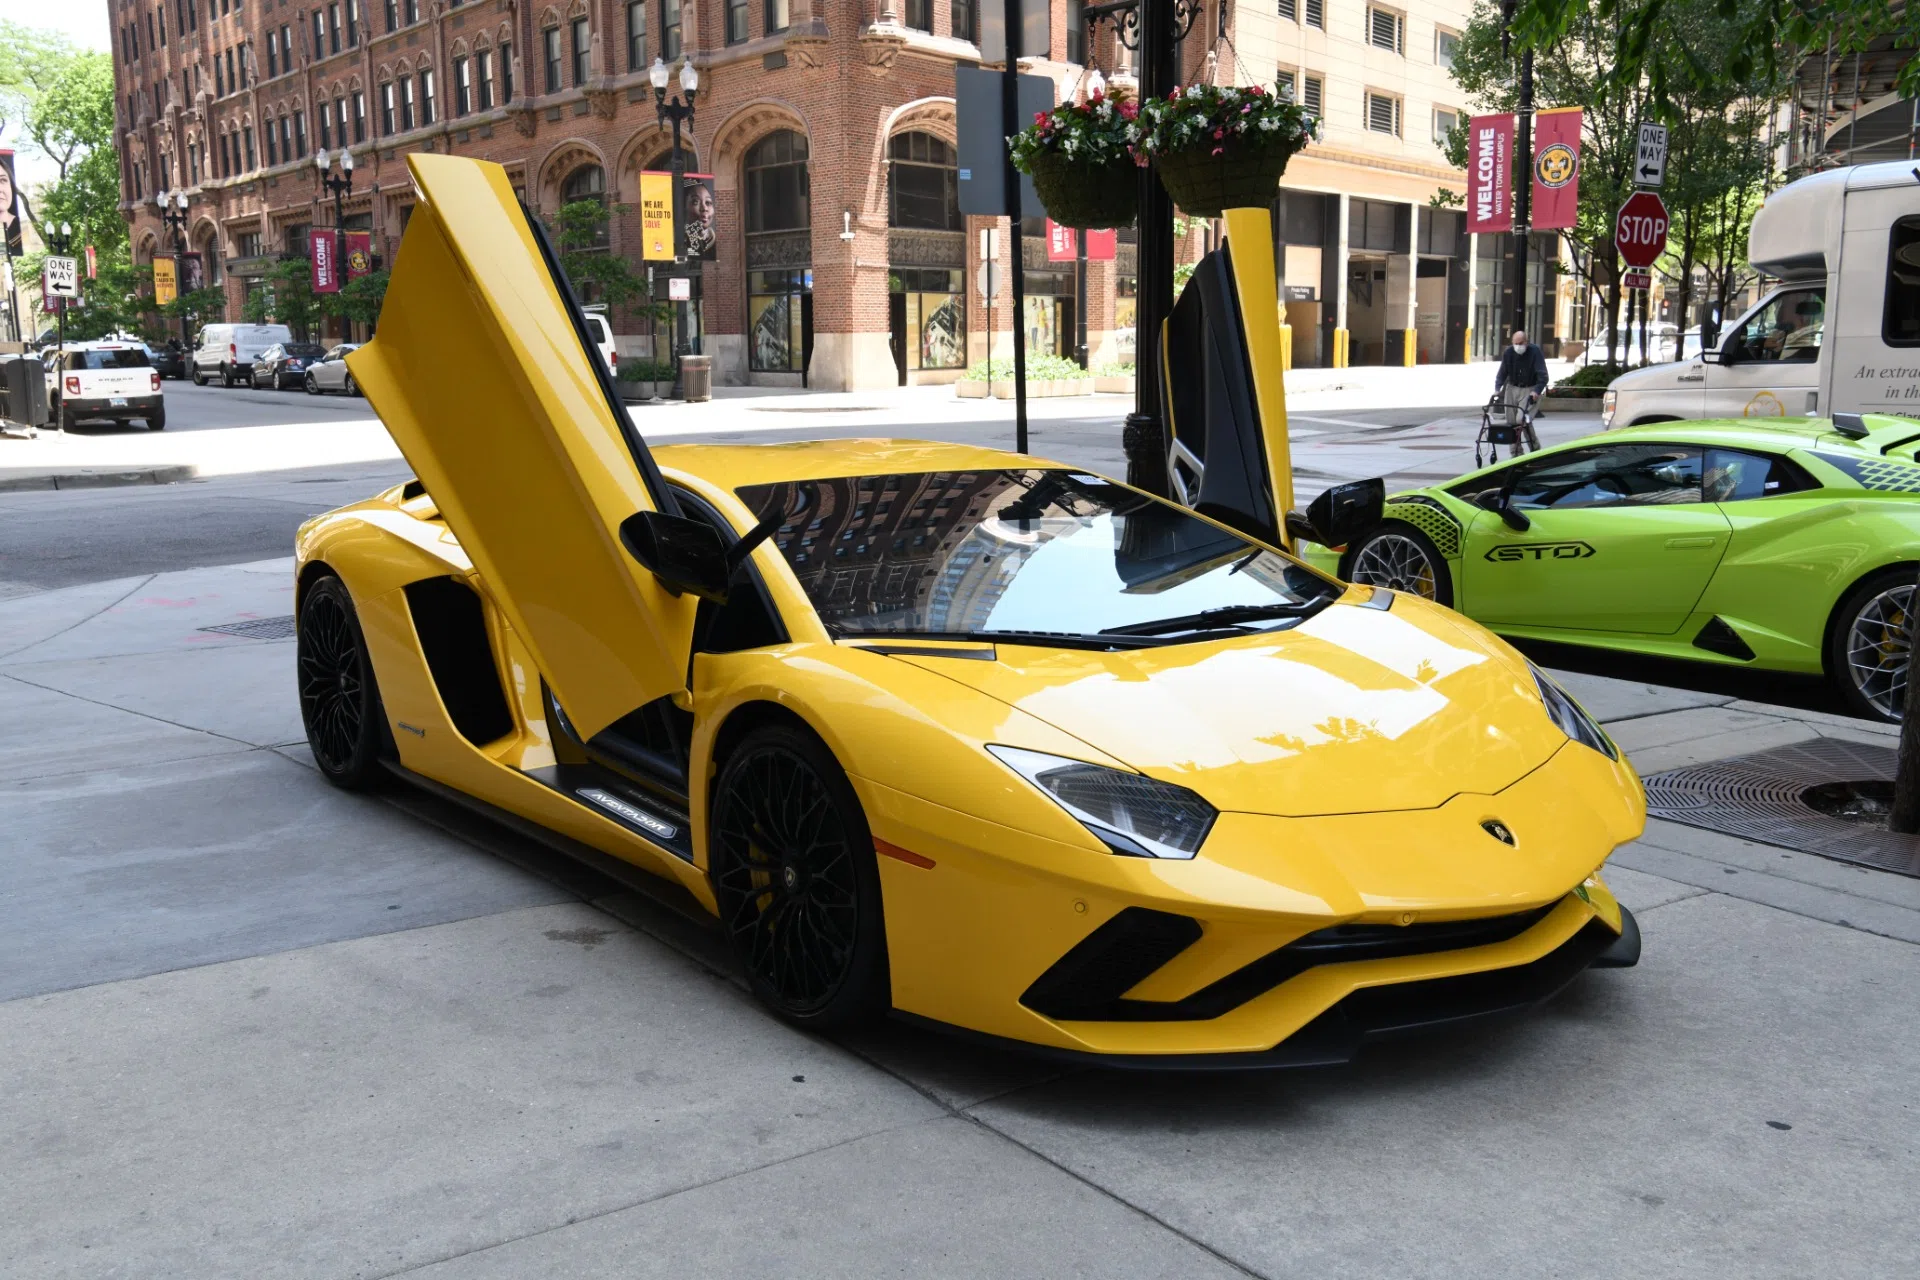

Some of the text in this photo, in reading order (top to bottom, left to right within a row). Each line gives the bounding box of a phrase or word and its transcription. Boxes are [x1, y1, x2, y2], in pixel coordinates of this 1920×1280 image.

[1642, 128, 1664, 145] ONE
[1496, 133, 1505, 165] CAMPUS
[1640, 145, 1663, 161] WAY
[1477, 128, 1494, 222] WELCOME
[1496, 165, 1504, 189] TOWER
[644, 200, 663, 209] WE ARE
[644, 210, 671, 219] CALLED TO
[644, 220, 660, 229] SOLVE
[1619, 215, 1665, 245] STOP
[50, 260, 72, 270] ONE
[316, 238, 327, 287] WELCOME
[50, 270, 73, 280] WAY
[1626, 275, 1637, 285] ALL
[1638, 276, 1649, 286] WAY
[1854, 365, 1920, 378] An extra
[1885, 385, 1920, 398] in th
[1498, 546, 1581, 561] STO
[591, 793, 666, 831] AVENTADOR
